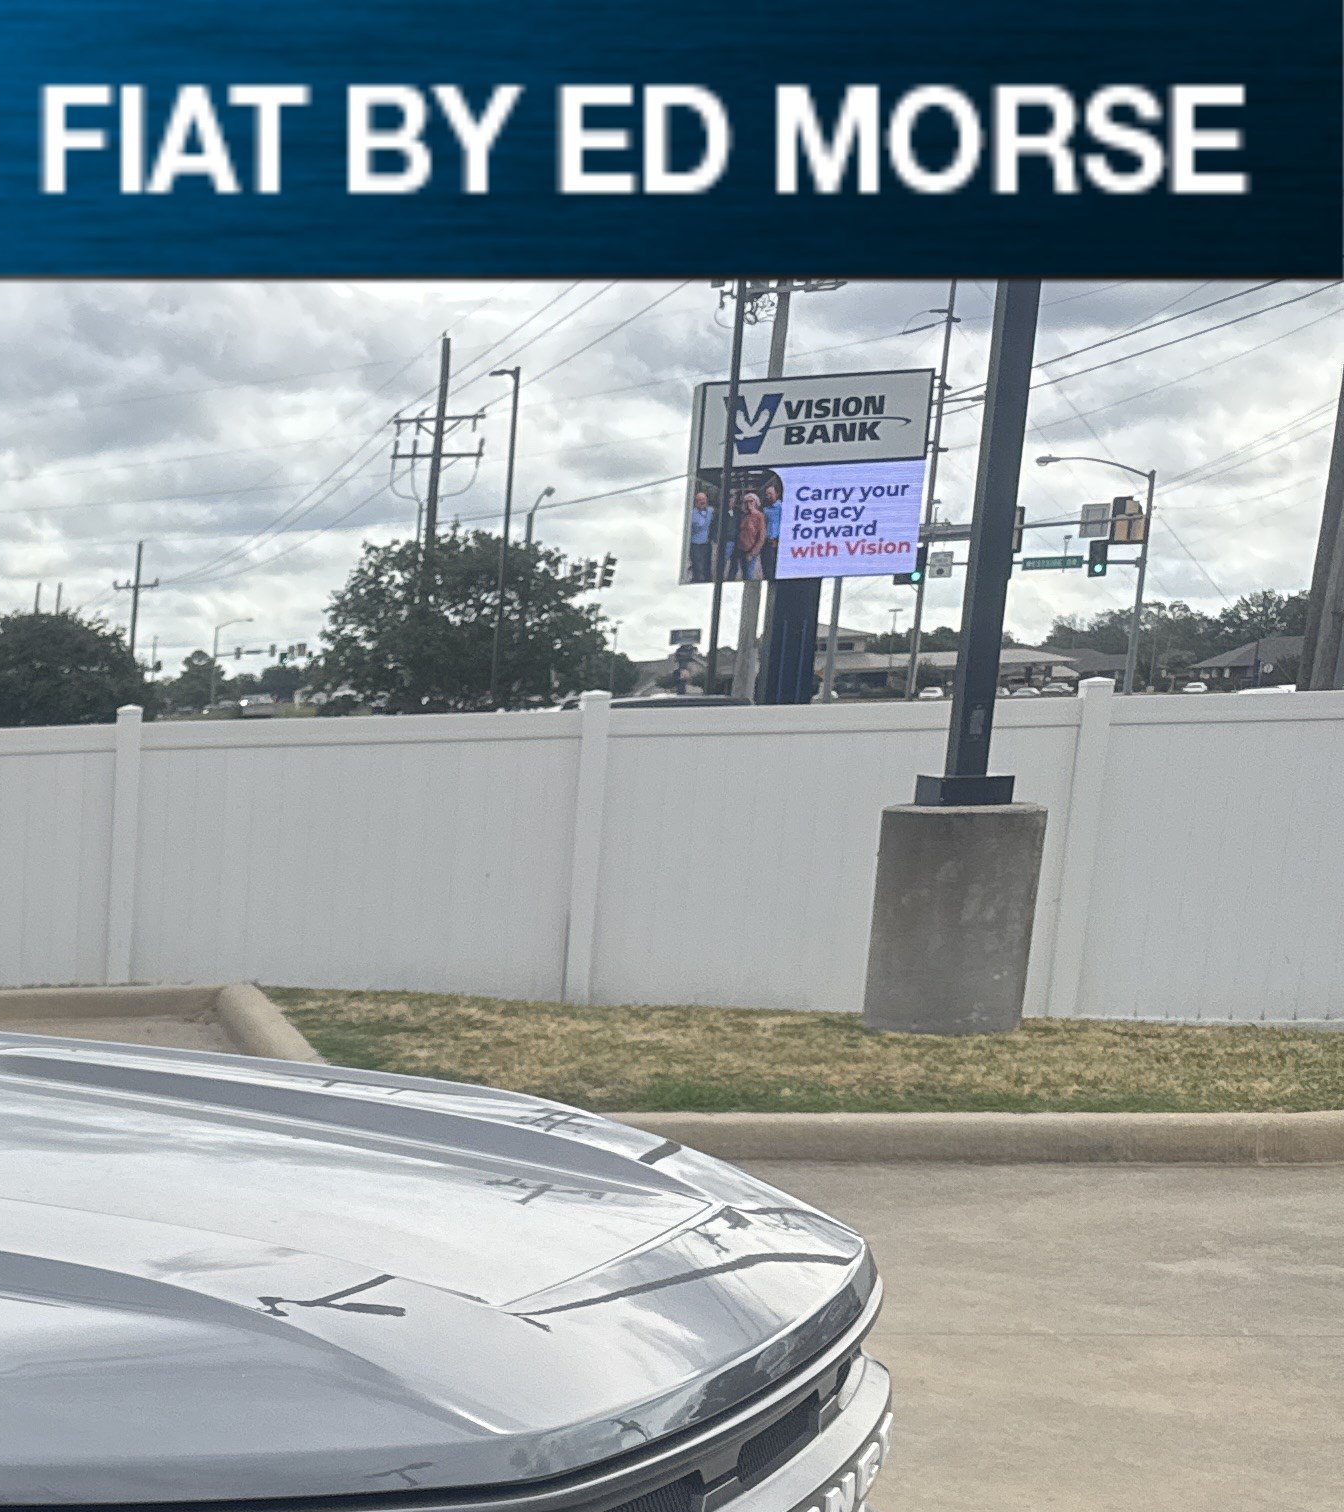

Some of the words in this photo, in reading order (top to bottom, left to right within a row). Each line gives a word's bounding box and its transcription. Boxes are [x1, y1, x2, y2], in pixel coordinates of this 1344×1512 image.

[783, 394, 886, 421] VISION
[783, 420, 882, 446] BANK
[795, 484, 856, 504] Carry
[858, 482, 911, 503] your
[793, 504, 866, 524] legacy
[791, 520, 878, 541] forward
[790, 541, 838, 560] with
[843, 538, 912, 557] Vision
